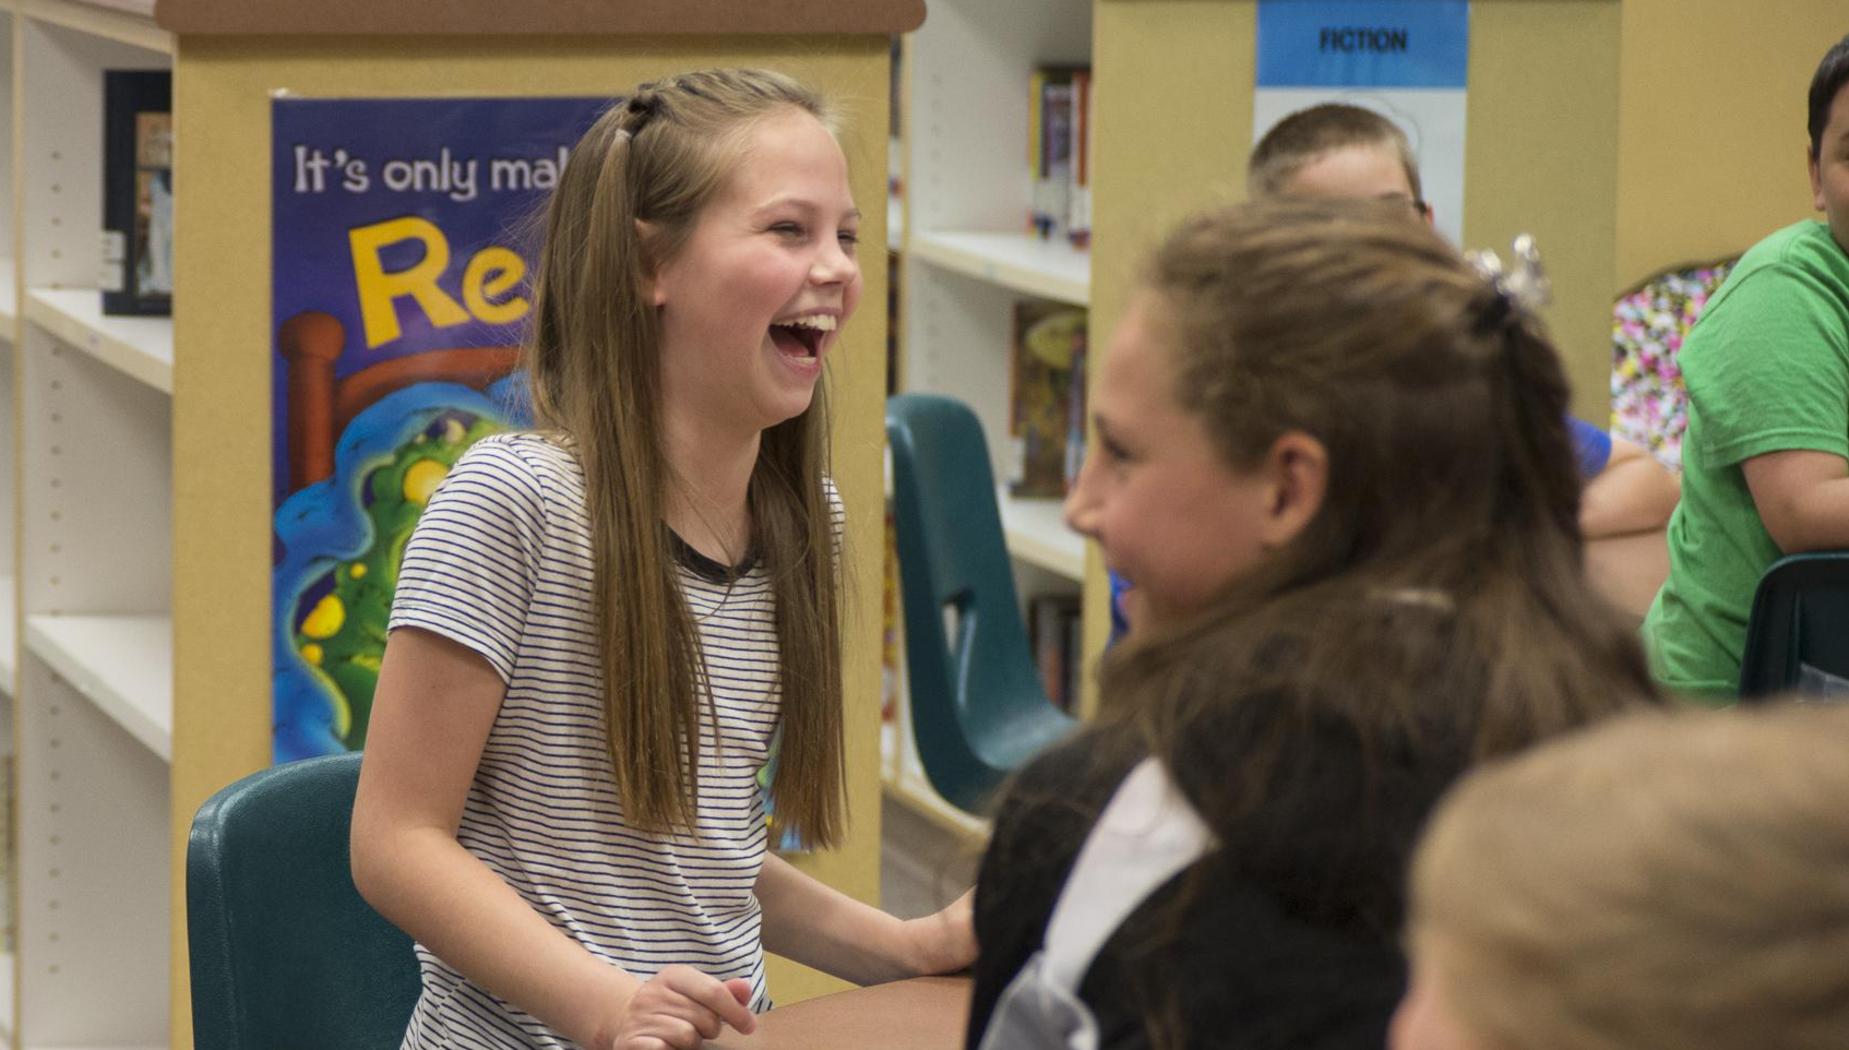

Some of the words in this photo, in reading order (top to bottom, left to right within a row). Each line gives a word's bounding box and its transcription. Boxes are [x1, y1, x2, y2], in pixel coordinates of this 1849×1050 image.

[1318, 28, 1408, 52] FICTION
[294, 145, 370, 192] It's
[382, 147, 479, 201] only
